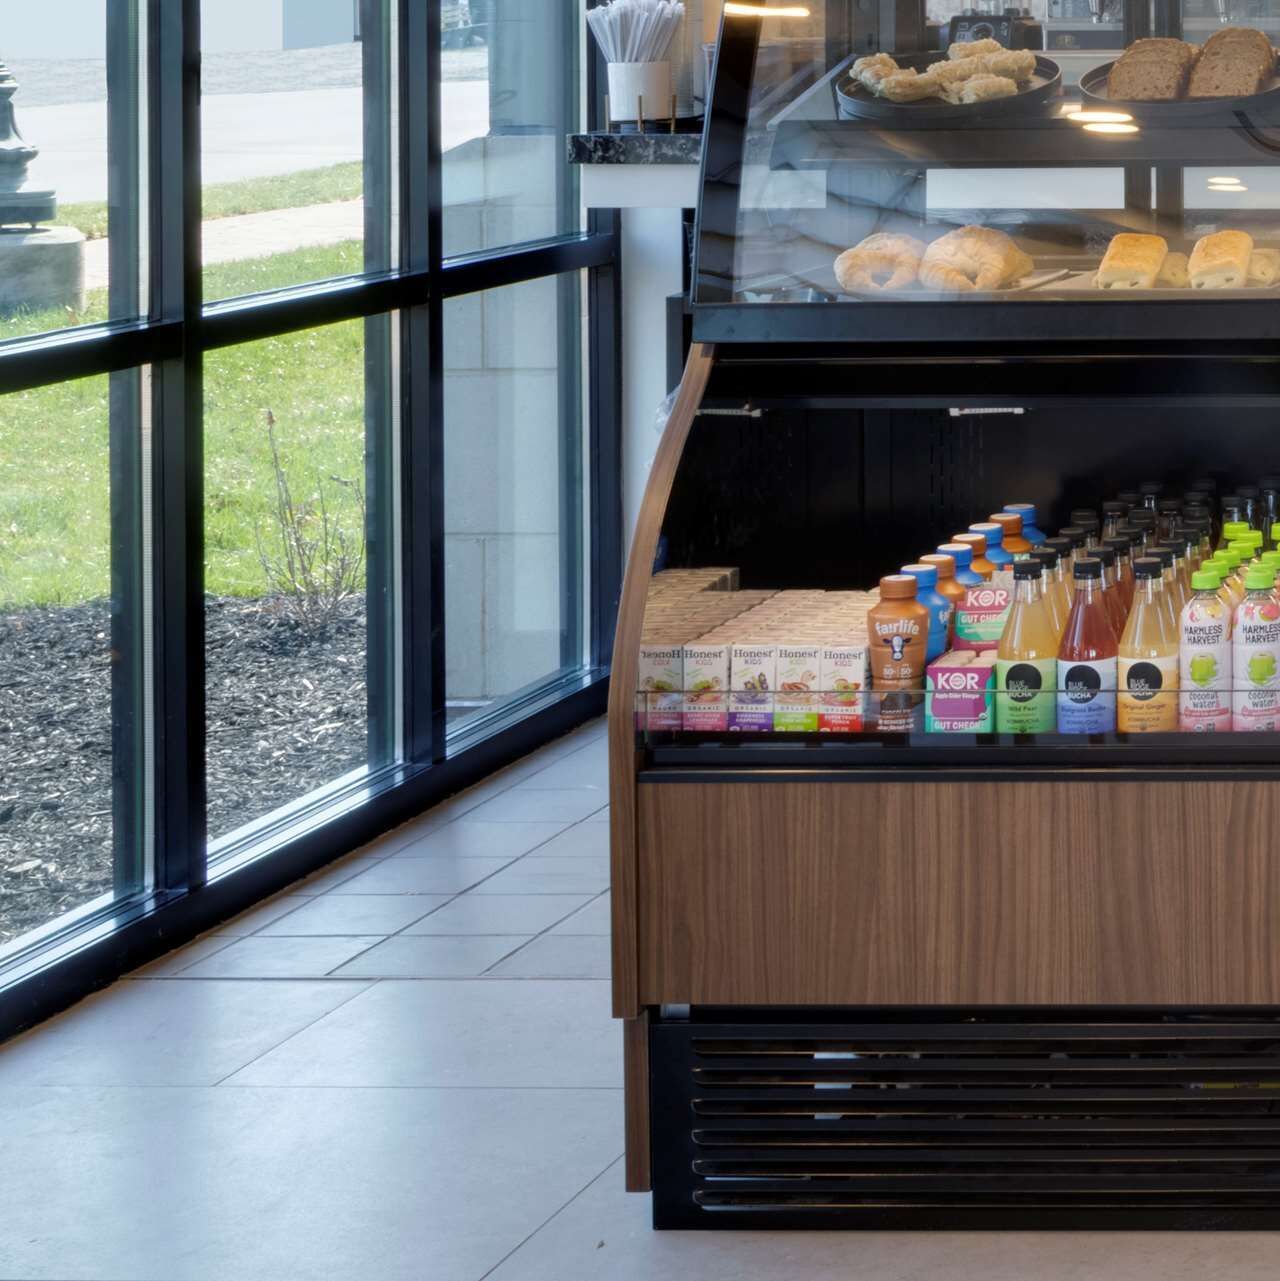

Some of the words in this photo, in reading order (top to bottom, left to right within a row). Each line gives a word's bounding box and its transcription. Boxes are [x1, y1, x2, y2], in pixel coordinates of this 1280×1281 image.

[967, 589, 1008, 607] KOR
[961, 613, 978, 624] GUT
[875, 618, 920, 636] fairlife
[1184, 624, 1223, 635] HARMLESS
[1242, 623, 1280, 634] HARMLESS
[1187, 634, 1220, 645] HARVEST
[1245, 633, 1279, 645] HARVEST
[684, 650, 723, 660] Honest
[733, 649, 773, 659] Honest
[779, 649, 818, 659] Honest
[824, 650, 864, 661] Honest
[937, 672, 980, 690] KOR
[1189, 691, 1219, 701] coconut
[1192, 699, 1217, 709] water
[1252, 699, 1275, 709] water
[934, 720, 952, 730] GUT
